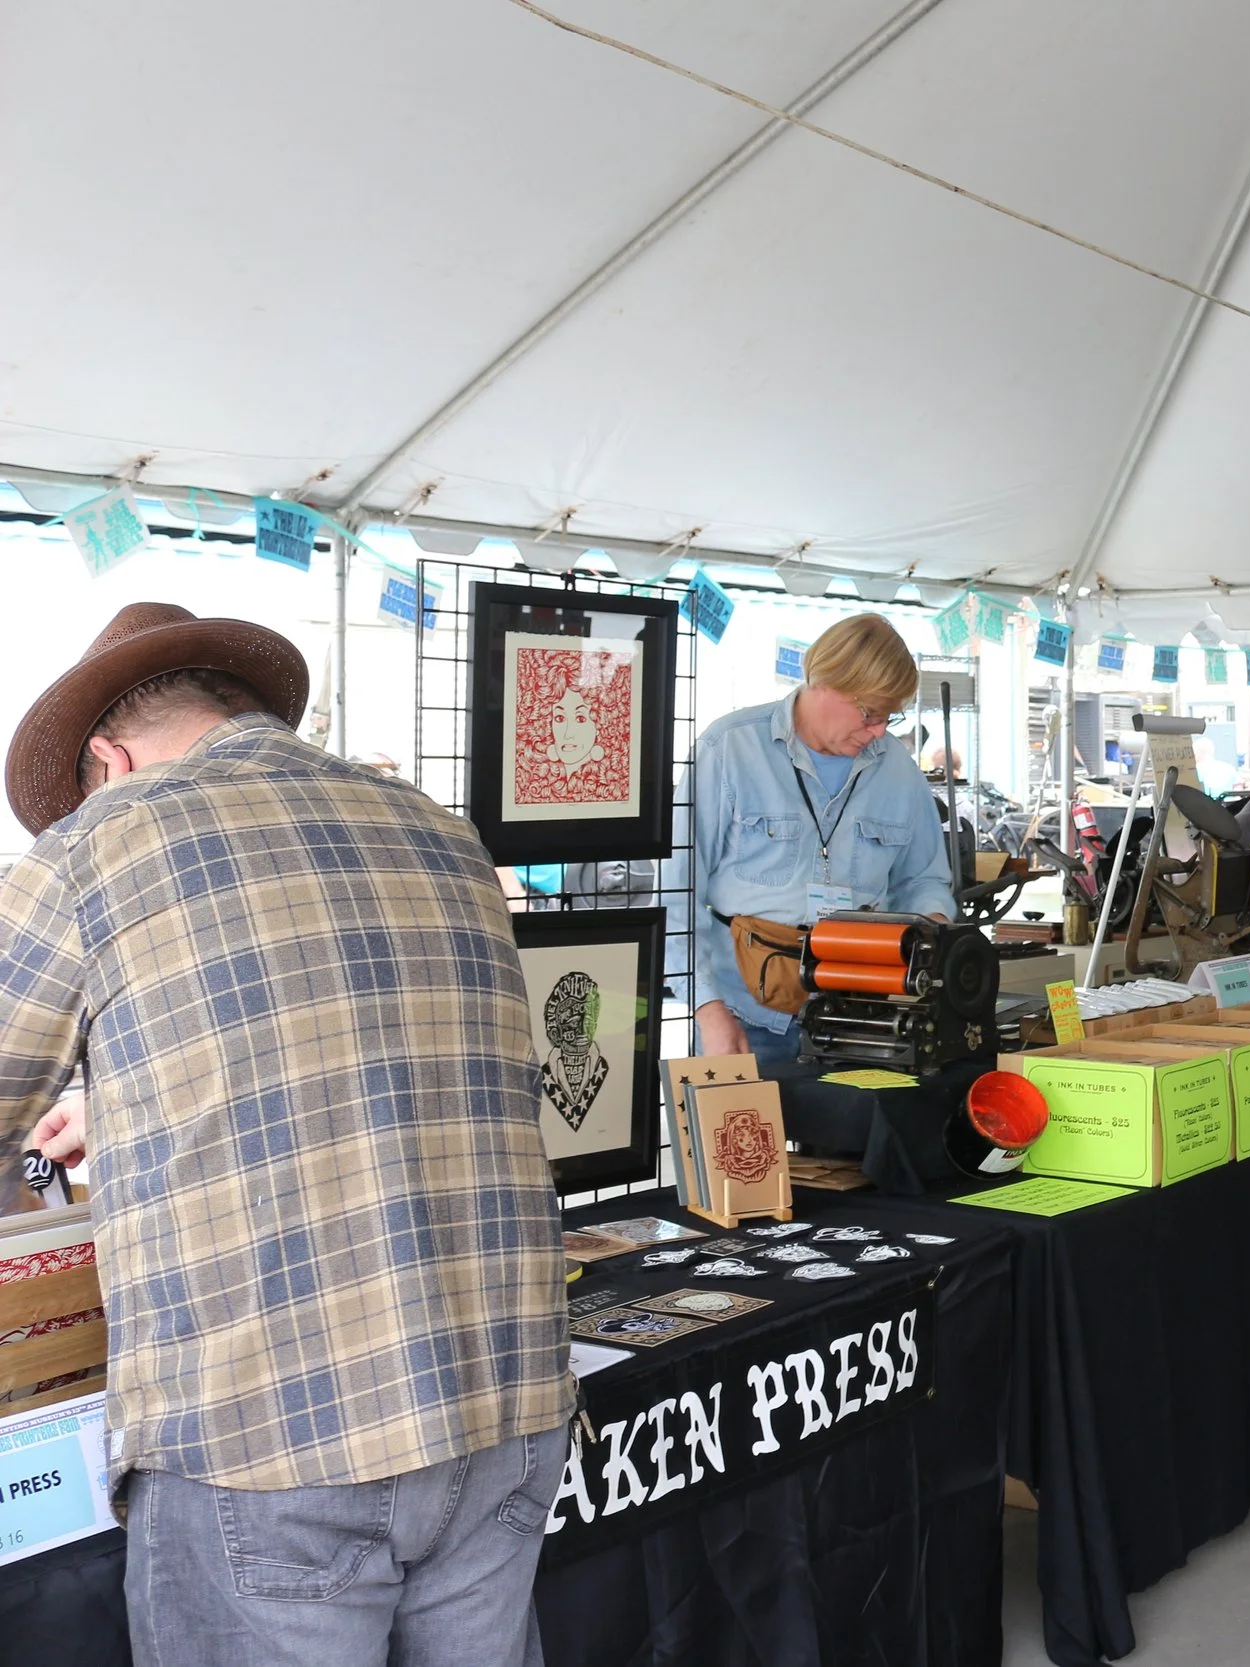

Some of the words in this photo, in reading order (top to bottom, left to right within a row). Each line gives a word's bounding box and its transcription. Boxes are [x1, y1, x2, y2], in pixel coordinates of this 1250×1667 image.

[547, 1000, 558, 1031] EVEL
[1058, 1081, 1073, 1089] INK
[1075, 1082, 1085, 1091] IN
[1087, 1083, 1117, 1093] TUBES
[1196, 1076, 1211, 1086] TUBES
[1049, 1111, 1102, 1126] luorescents
[1112, 1116, 1130, 1128] $25
[1087, 1126, 1114, 1139] Colors)
[23, 1156, 52, 1181] 20
[747, 1308, 918, 1457] PRESS
[9, 1469, 62, 1500] PRESS
[8, 1529, 24, 1546] 16
